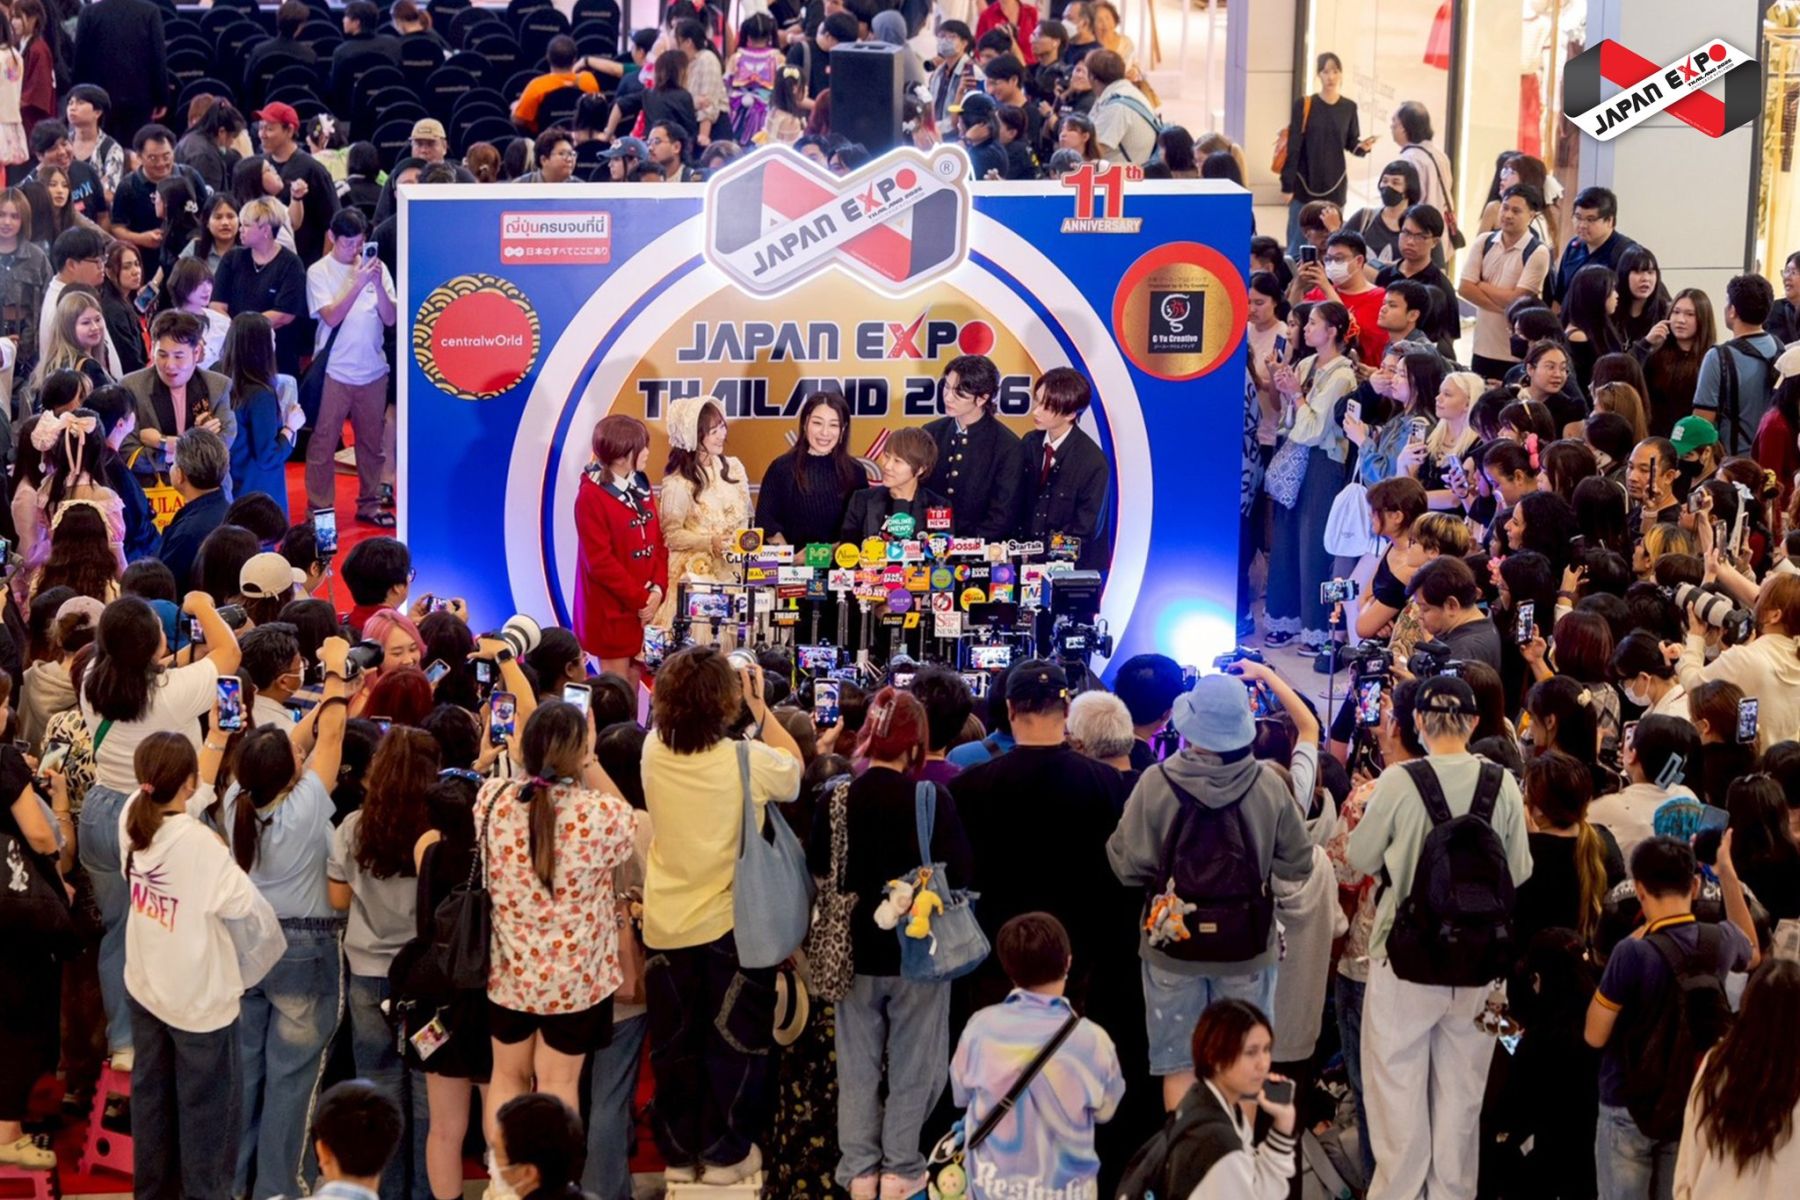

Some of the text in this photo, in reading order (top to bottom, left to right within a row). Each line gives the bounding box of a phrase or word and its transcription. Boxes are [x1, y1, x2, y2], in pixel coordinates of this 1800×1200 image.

[753, 213, 838, 277] JAPAN
[840, 168, 917, 223] EXPO
[1063, 220, 1140, 232] ANNIVERSARY
[677, 321, 840, 362] JAPAN
[1169, 334, 1198, 343] Creative
[932, 510, 948, 519] TBT
